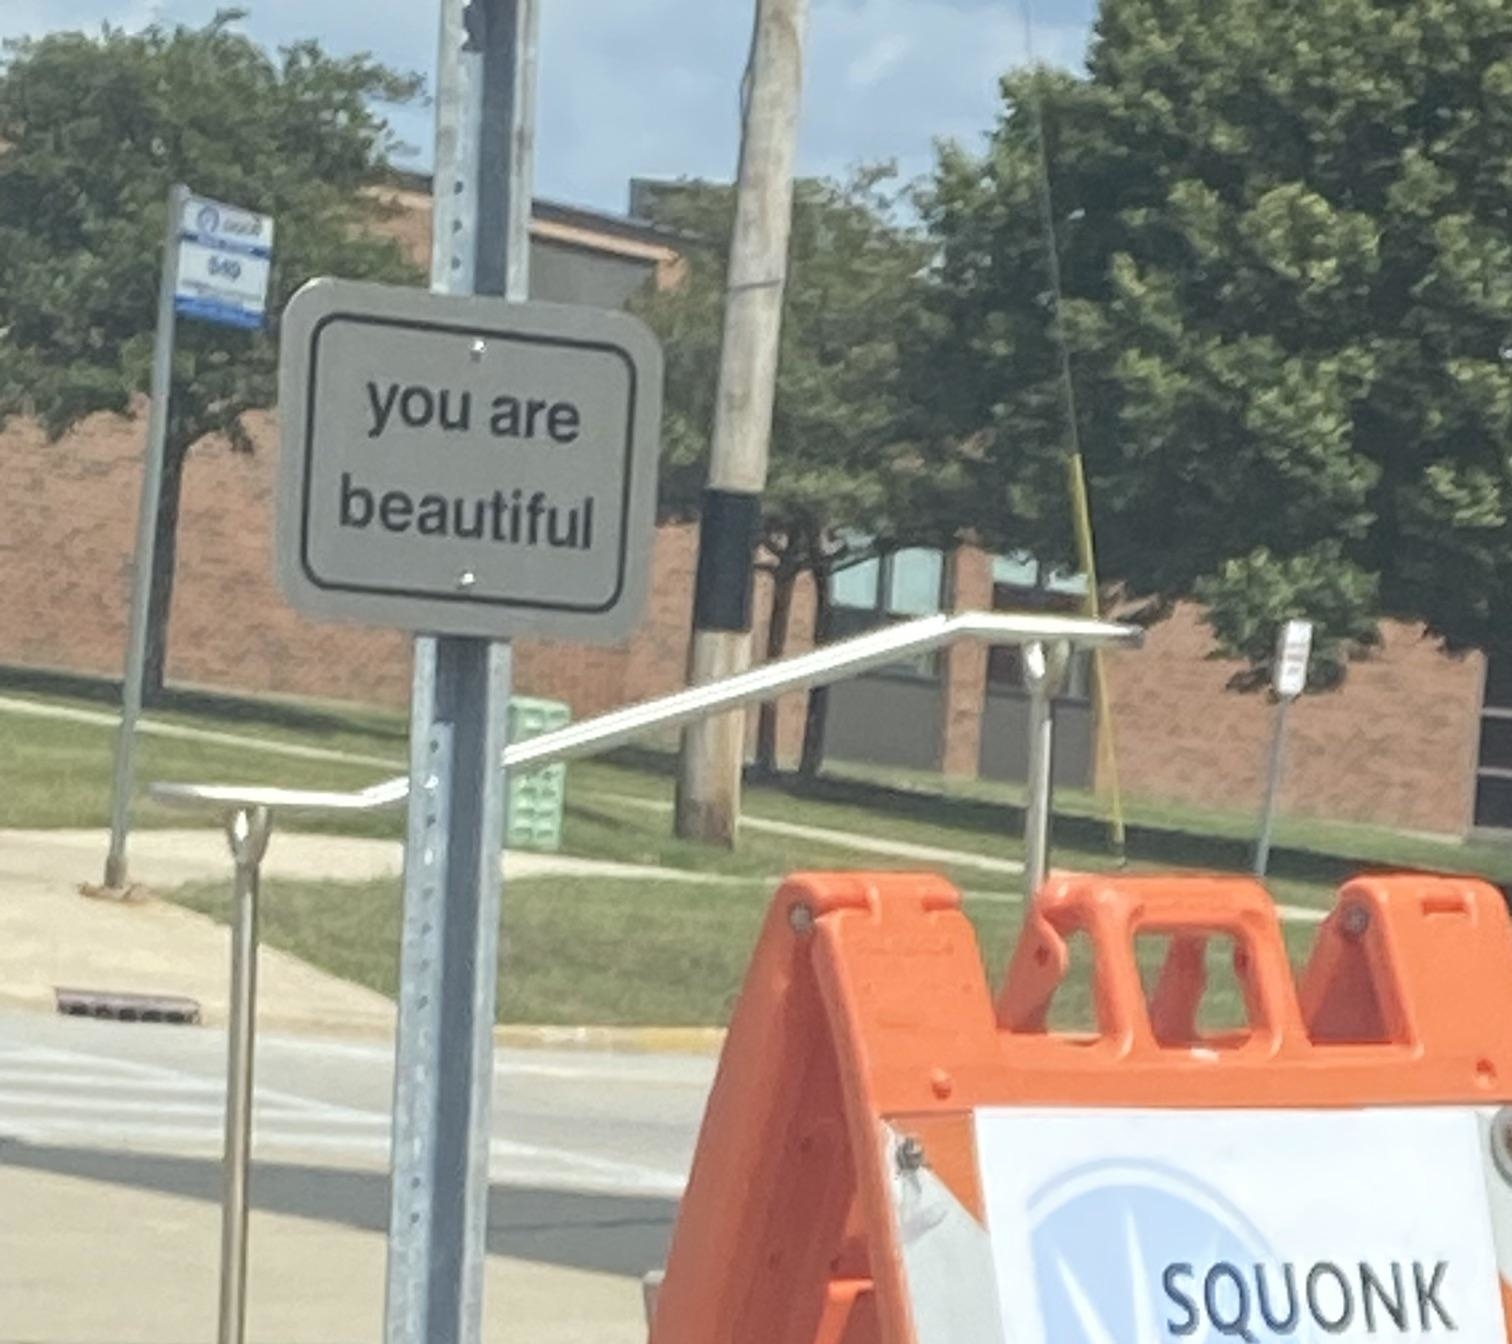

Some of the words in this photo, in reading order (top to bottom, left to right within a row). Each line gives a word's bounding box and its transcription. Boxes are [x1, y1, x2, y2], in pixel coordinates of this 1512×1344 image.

[367, 381, 471, 438] you
[490, 395, 580, 443] are
[339, 472, 594, 550] beautiful
[1162, 1261, 1458, 1344] SQUONK
